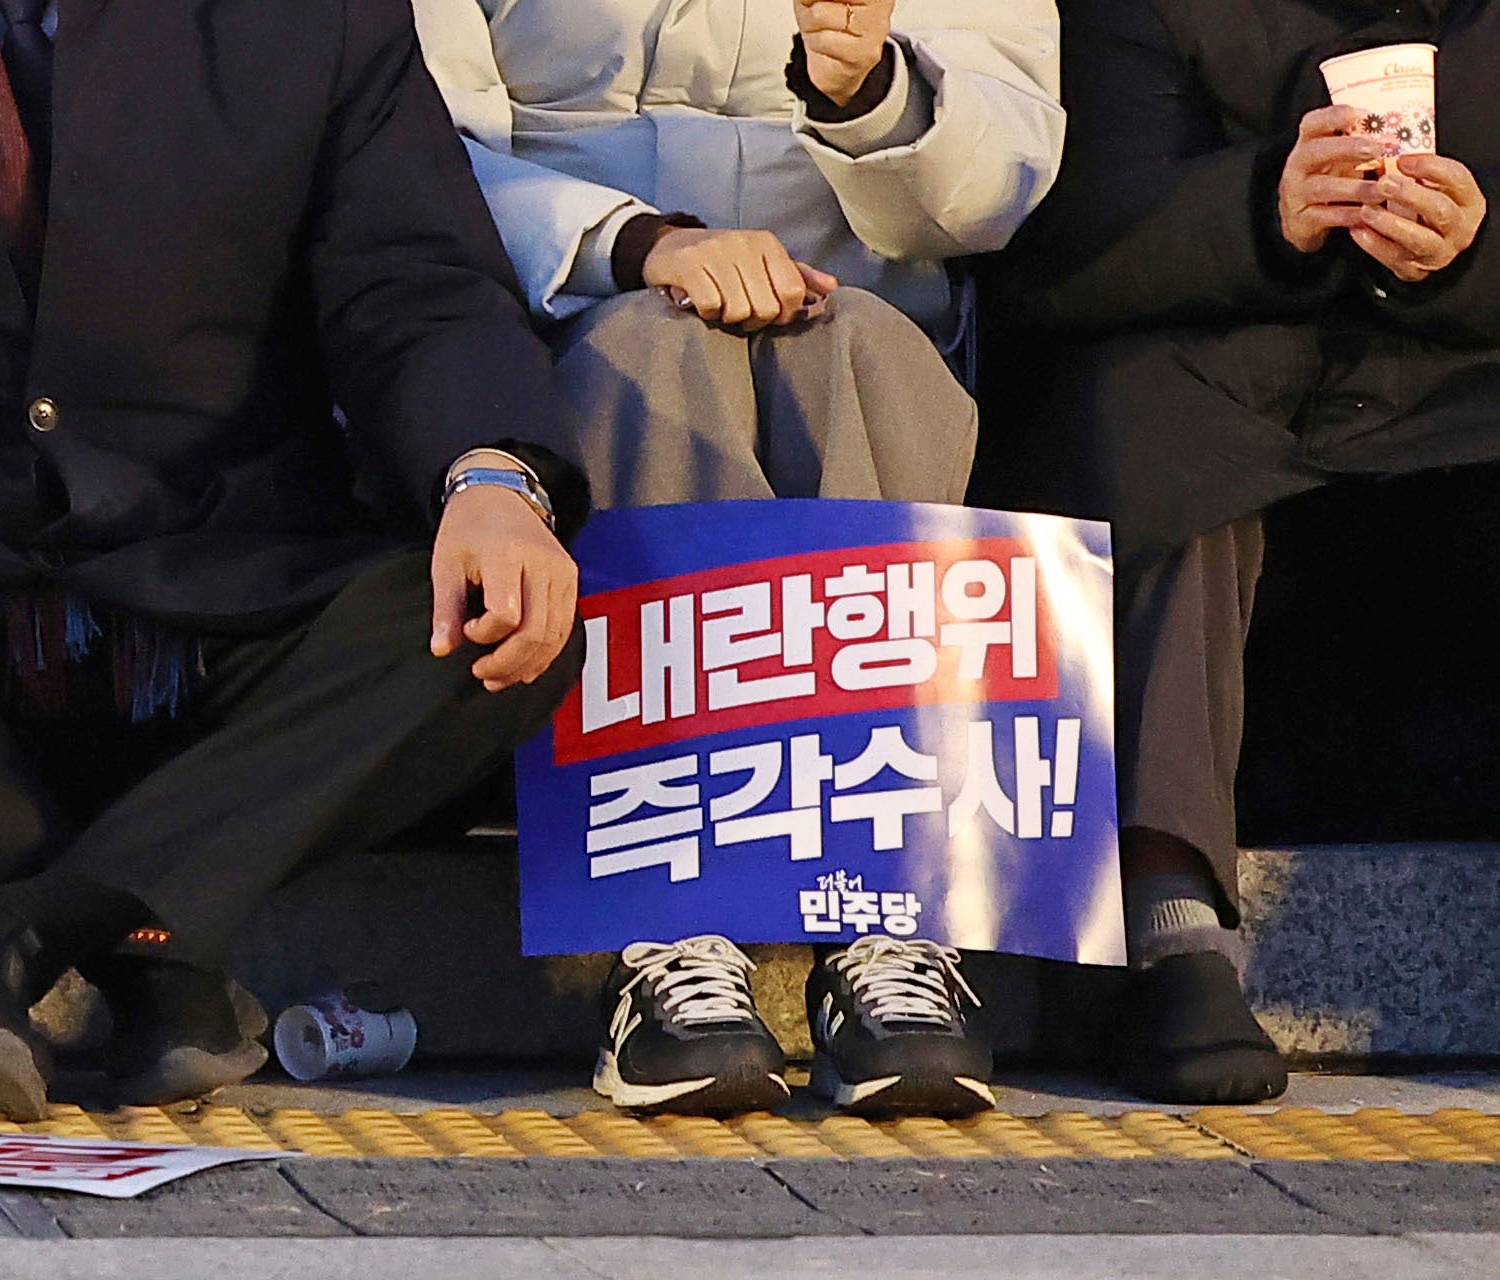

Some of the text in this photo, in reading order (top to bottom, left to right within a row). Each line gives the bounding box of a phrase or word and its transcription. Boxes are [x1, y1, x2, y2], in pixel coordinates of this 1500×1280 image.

[581, 556, 1037, 734] 내란행위
[588, 717, 1080, 881] 즉각수사!
[800, 892, 921, 935] 민주당
[816, 873, 863, 894] 더불어
